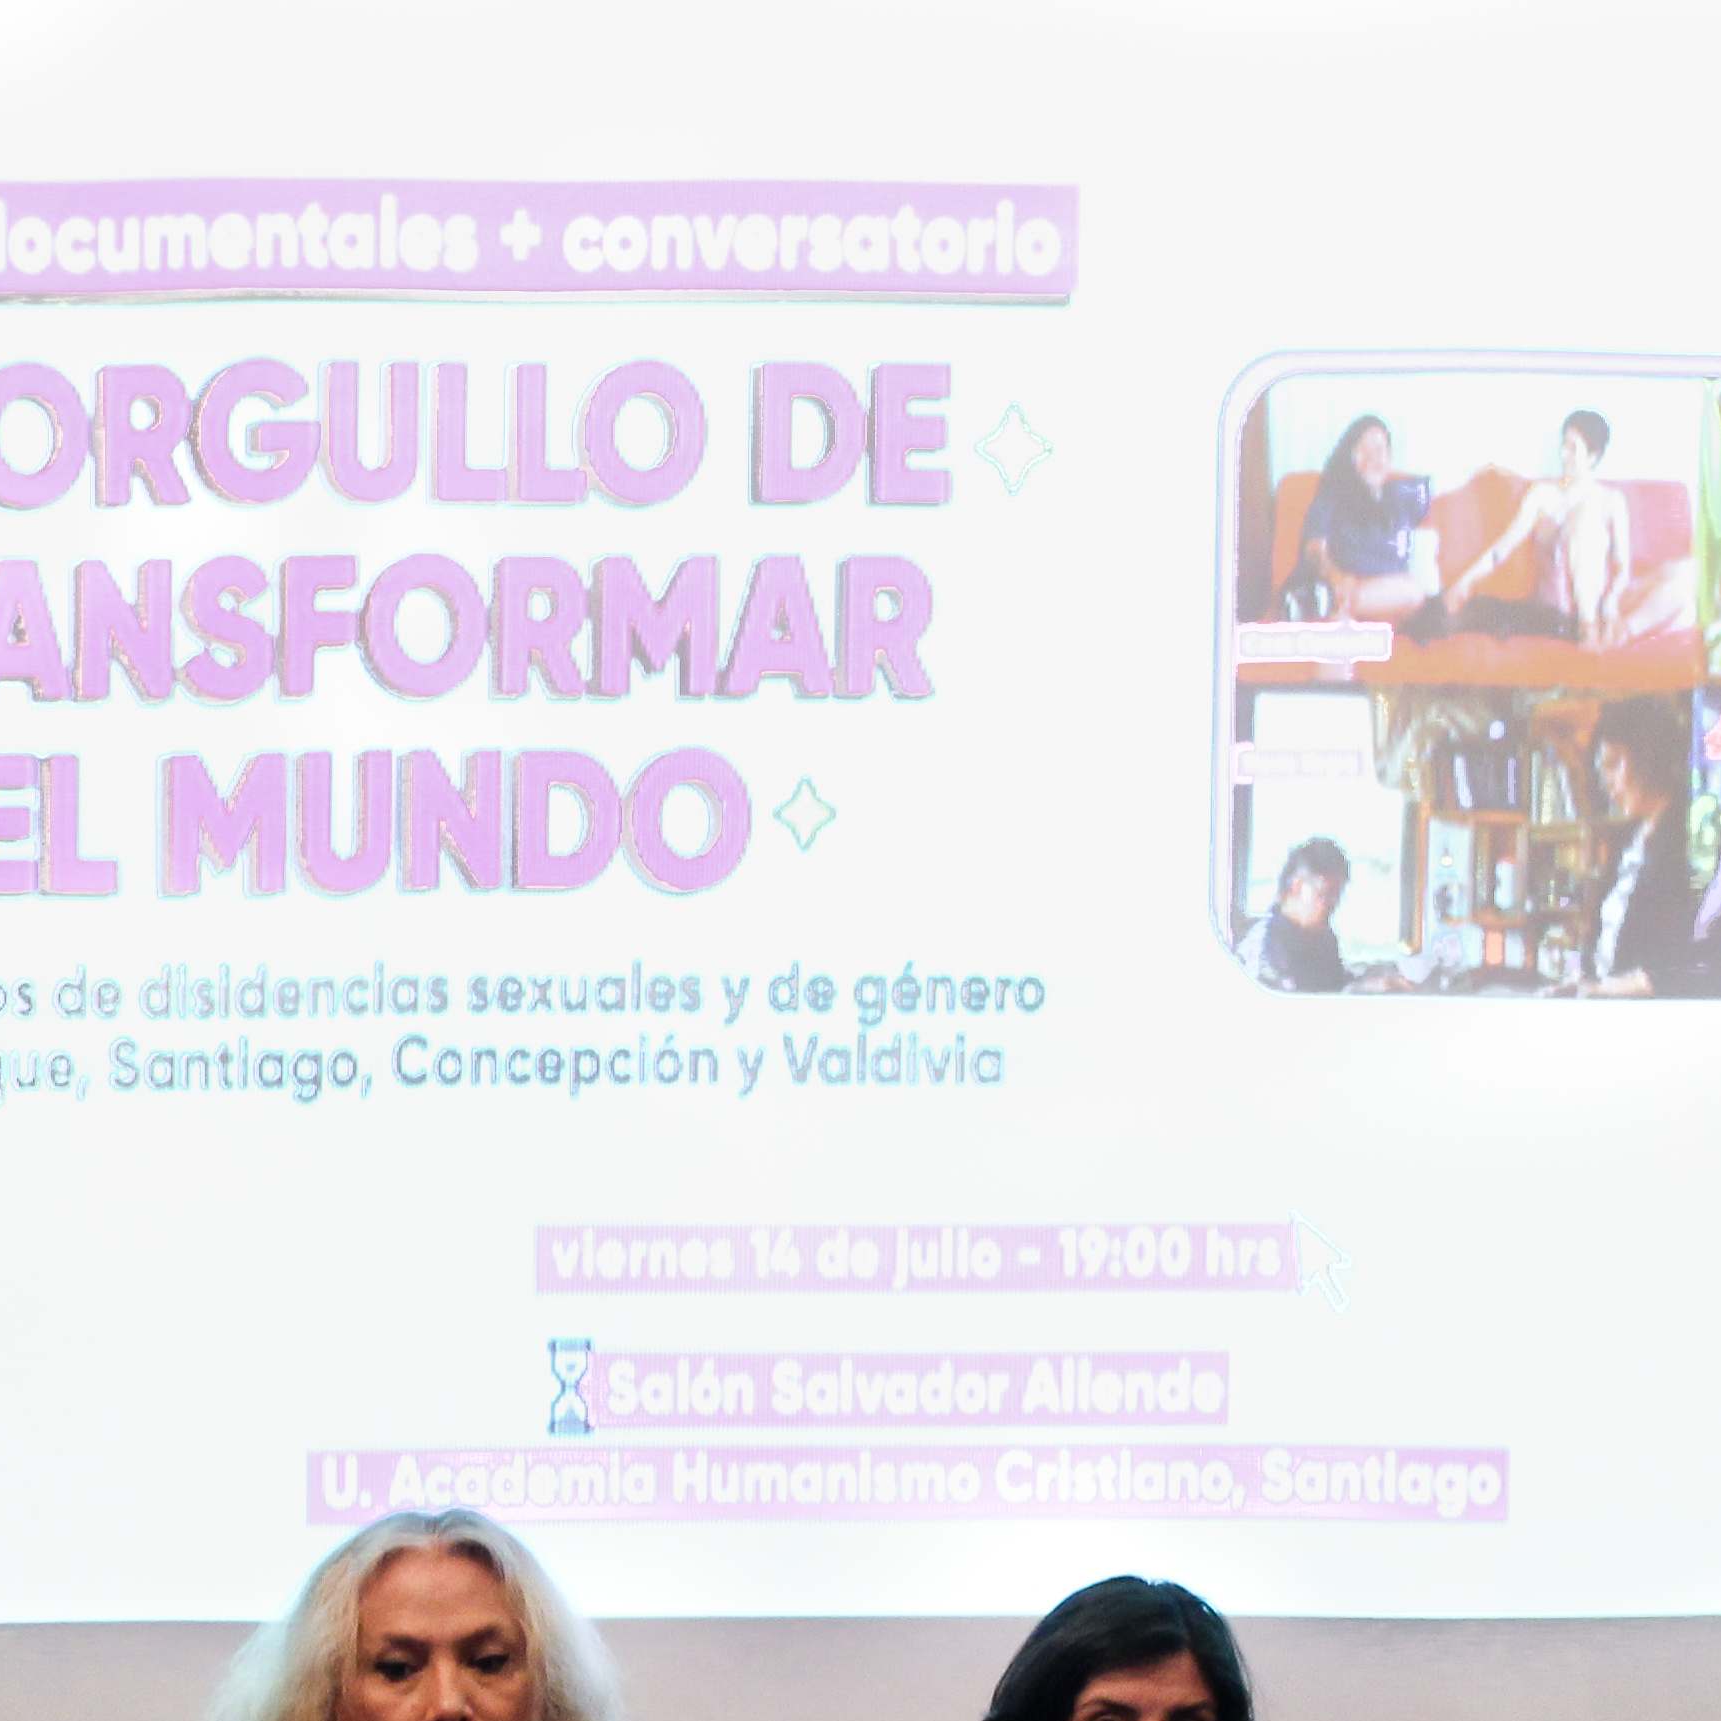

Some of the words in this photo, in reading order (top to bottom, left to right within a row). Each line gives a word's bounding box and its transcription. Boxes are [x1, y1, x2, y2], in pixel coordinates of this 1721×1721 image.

[562, 198, 1063, 277] conversatorio
[749, 361, 952, 508] DE
[157, 747, 753, 896] MUNDO
[52, 963, 121, 1019] de
[139, 961, 450, 1019] disidencias
[466, 960, 702, 1016] sexuales
[721, 972, 751, 1027] y
[768, 961, 837, 1015] de
[852, 961, 1047, 1028] género
[107, 1035, 373, 1104] Santiago,
[390, 1029, 719, 1099] Concepción
[735, 1044, 765, 1098] y
[781, 1030, 1006, 1086] Valdivia
[550, 1229, 736, 1279] viernes
[748, 1228, 801, 1279] 14
[815, 1228, 880, 1278] de
[891, 1226, 1002, 1293] julio
[1057, 1226, 1193, 1279] 19:00
[1205, 1226, 1283, 1278] hrs
[605, 1357, 757, 1415] Salón
[771, 1357, 1011, 1415] Salvador
[1022, 1356, 1226, 1415] Allende
[320, 1452, 374, 1509] U.
[388, 1452, 658, 1508] Academia
[672, 1448, 982, 1505] Humanismo
[994, 1447, 1246, 1511] Cristiano,
[1260, 1447, 1503, 1520] Santiago
